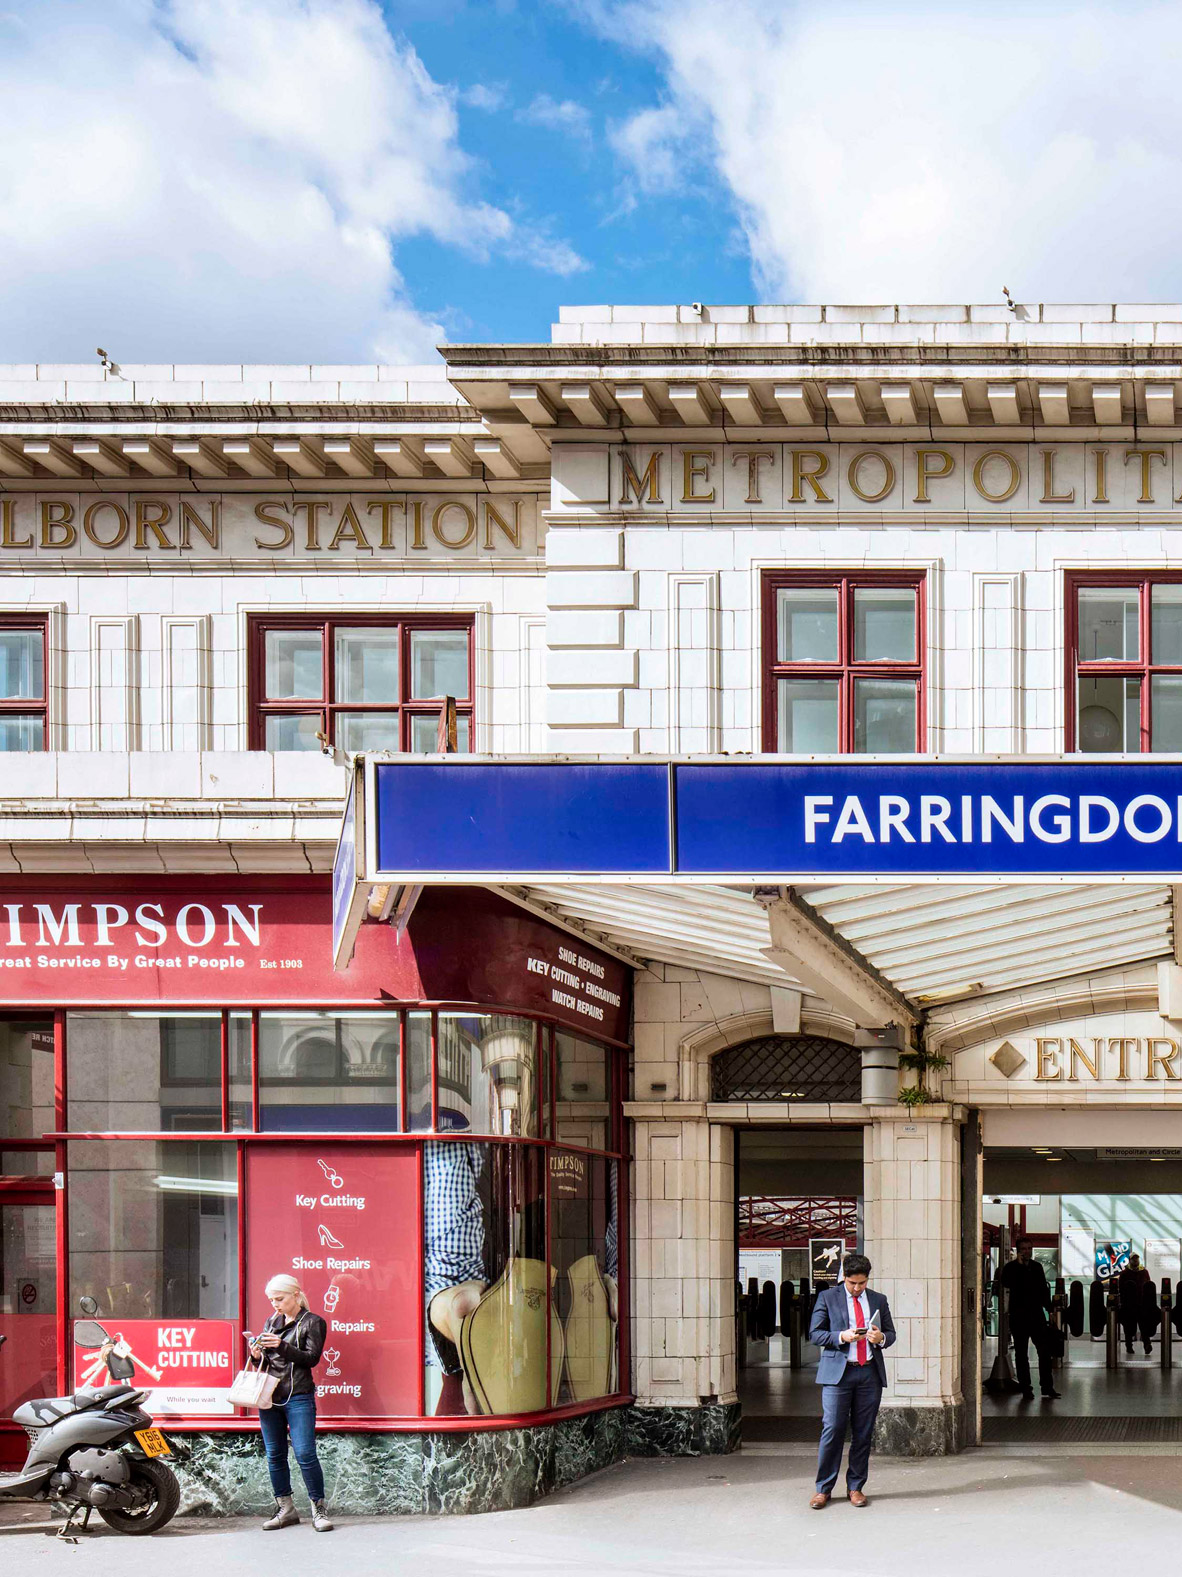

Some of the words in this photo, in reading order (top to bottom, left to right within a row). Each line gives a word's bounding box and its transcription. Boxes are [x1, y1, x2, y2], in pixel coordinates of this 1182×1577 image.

[0, 500, 220, 550] LBORN
[253, 499, 524, 550] STATION
[3, 903, 263, 948] IMPSON
[0, 956, 31, 968] reat
[37, 955, 101, 968] Service
[107, 955, 129, 970] By
[134, 955, 182, 968] Great
[188, 955, 245, 970] People
[260, 959, 277, 969] Est
[280, 959, 303, 969] 1903
[558, 947, 577, 966] SHOE
[577, 955, 604, 979] REPAIRS
[527, 958, 549, 976] KEY
[551, 965, 580, 990] CUTTING
[585, 981, 620, 1008] ENGRAVING
[552, 988, 575, 1010] WATCH
[576, 998, 604, 1021] REPAIRS
[1106, 1148, 1147, 1156] Metropolitan
[550, 1156, 583, 1174] TIMPSON
[295, 1194, 317, 1210] Key
[320, 1194, 366, 1210] Cutting
[1097, 1242, 1130, 1264] MND
[292, 1256, 323, 1270] Shoe
[326, 1257, 371, 1272] Repairs
[1097, 1256, 1130, 1278] GAP
[331, 1319, 375, 1335] Repairs
[157, 1327, 196, 1348] KEY
[158, 1351, 229, 1368] CUTTING
[316, 1381, 362, 1398] graving
[139, 1430, 160, 1443] Y616
